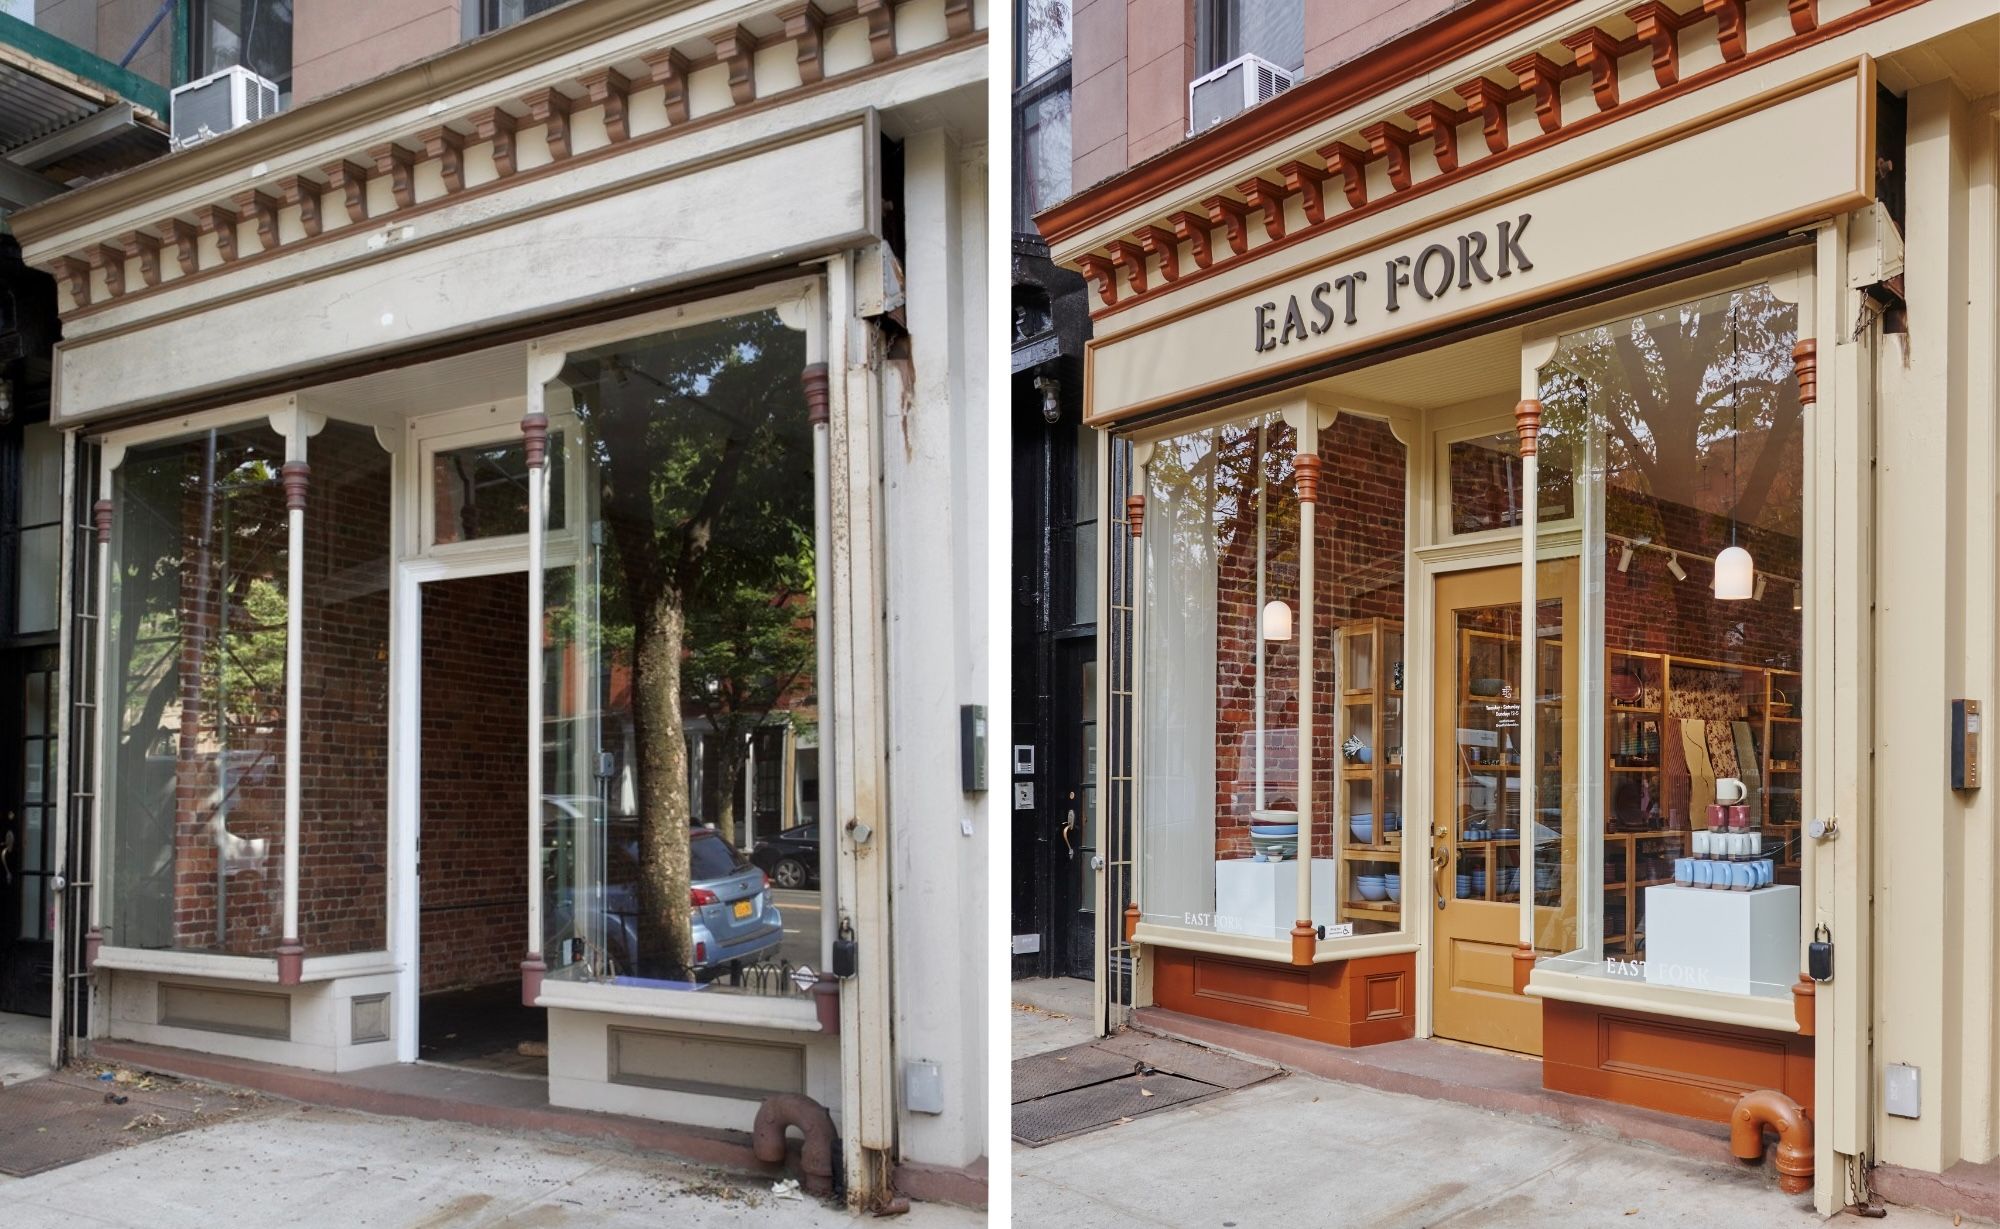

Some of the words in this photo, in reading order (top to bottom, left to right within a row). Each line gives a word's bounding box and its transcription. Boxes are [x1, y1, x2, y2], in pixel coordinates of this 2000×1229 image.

[1255, 271, 1367, 352] EAST
[1385, 213, 1534, 312] FORK
[1184, 912, 1210, 927] EAST
[1214, 914, 1242, 930] FORK
[1606, 957, 1648, 978] EAST
[1658, 963, 1710, 985] FORK
